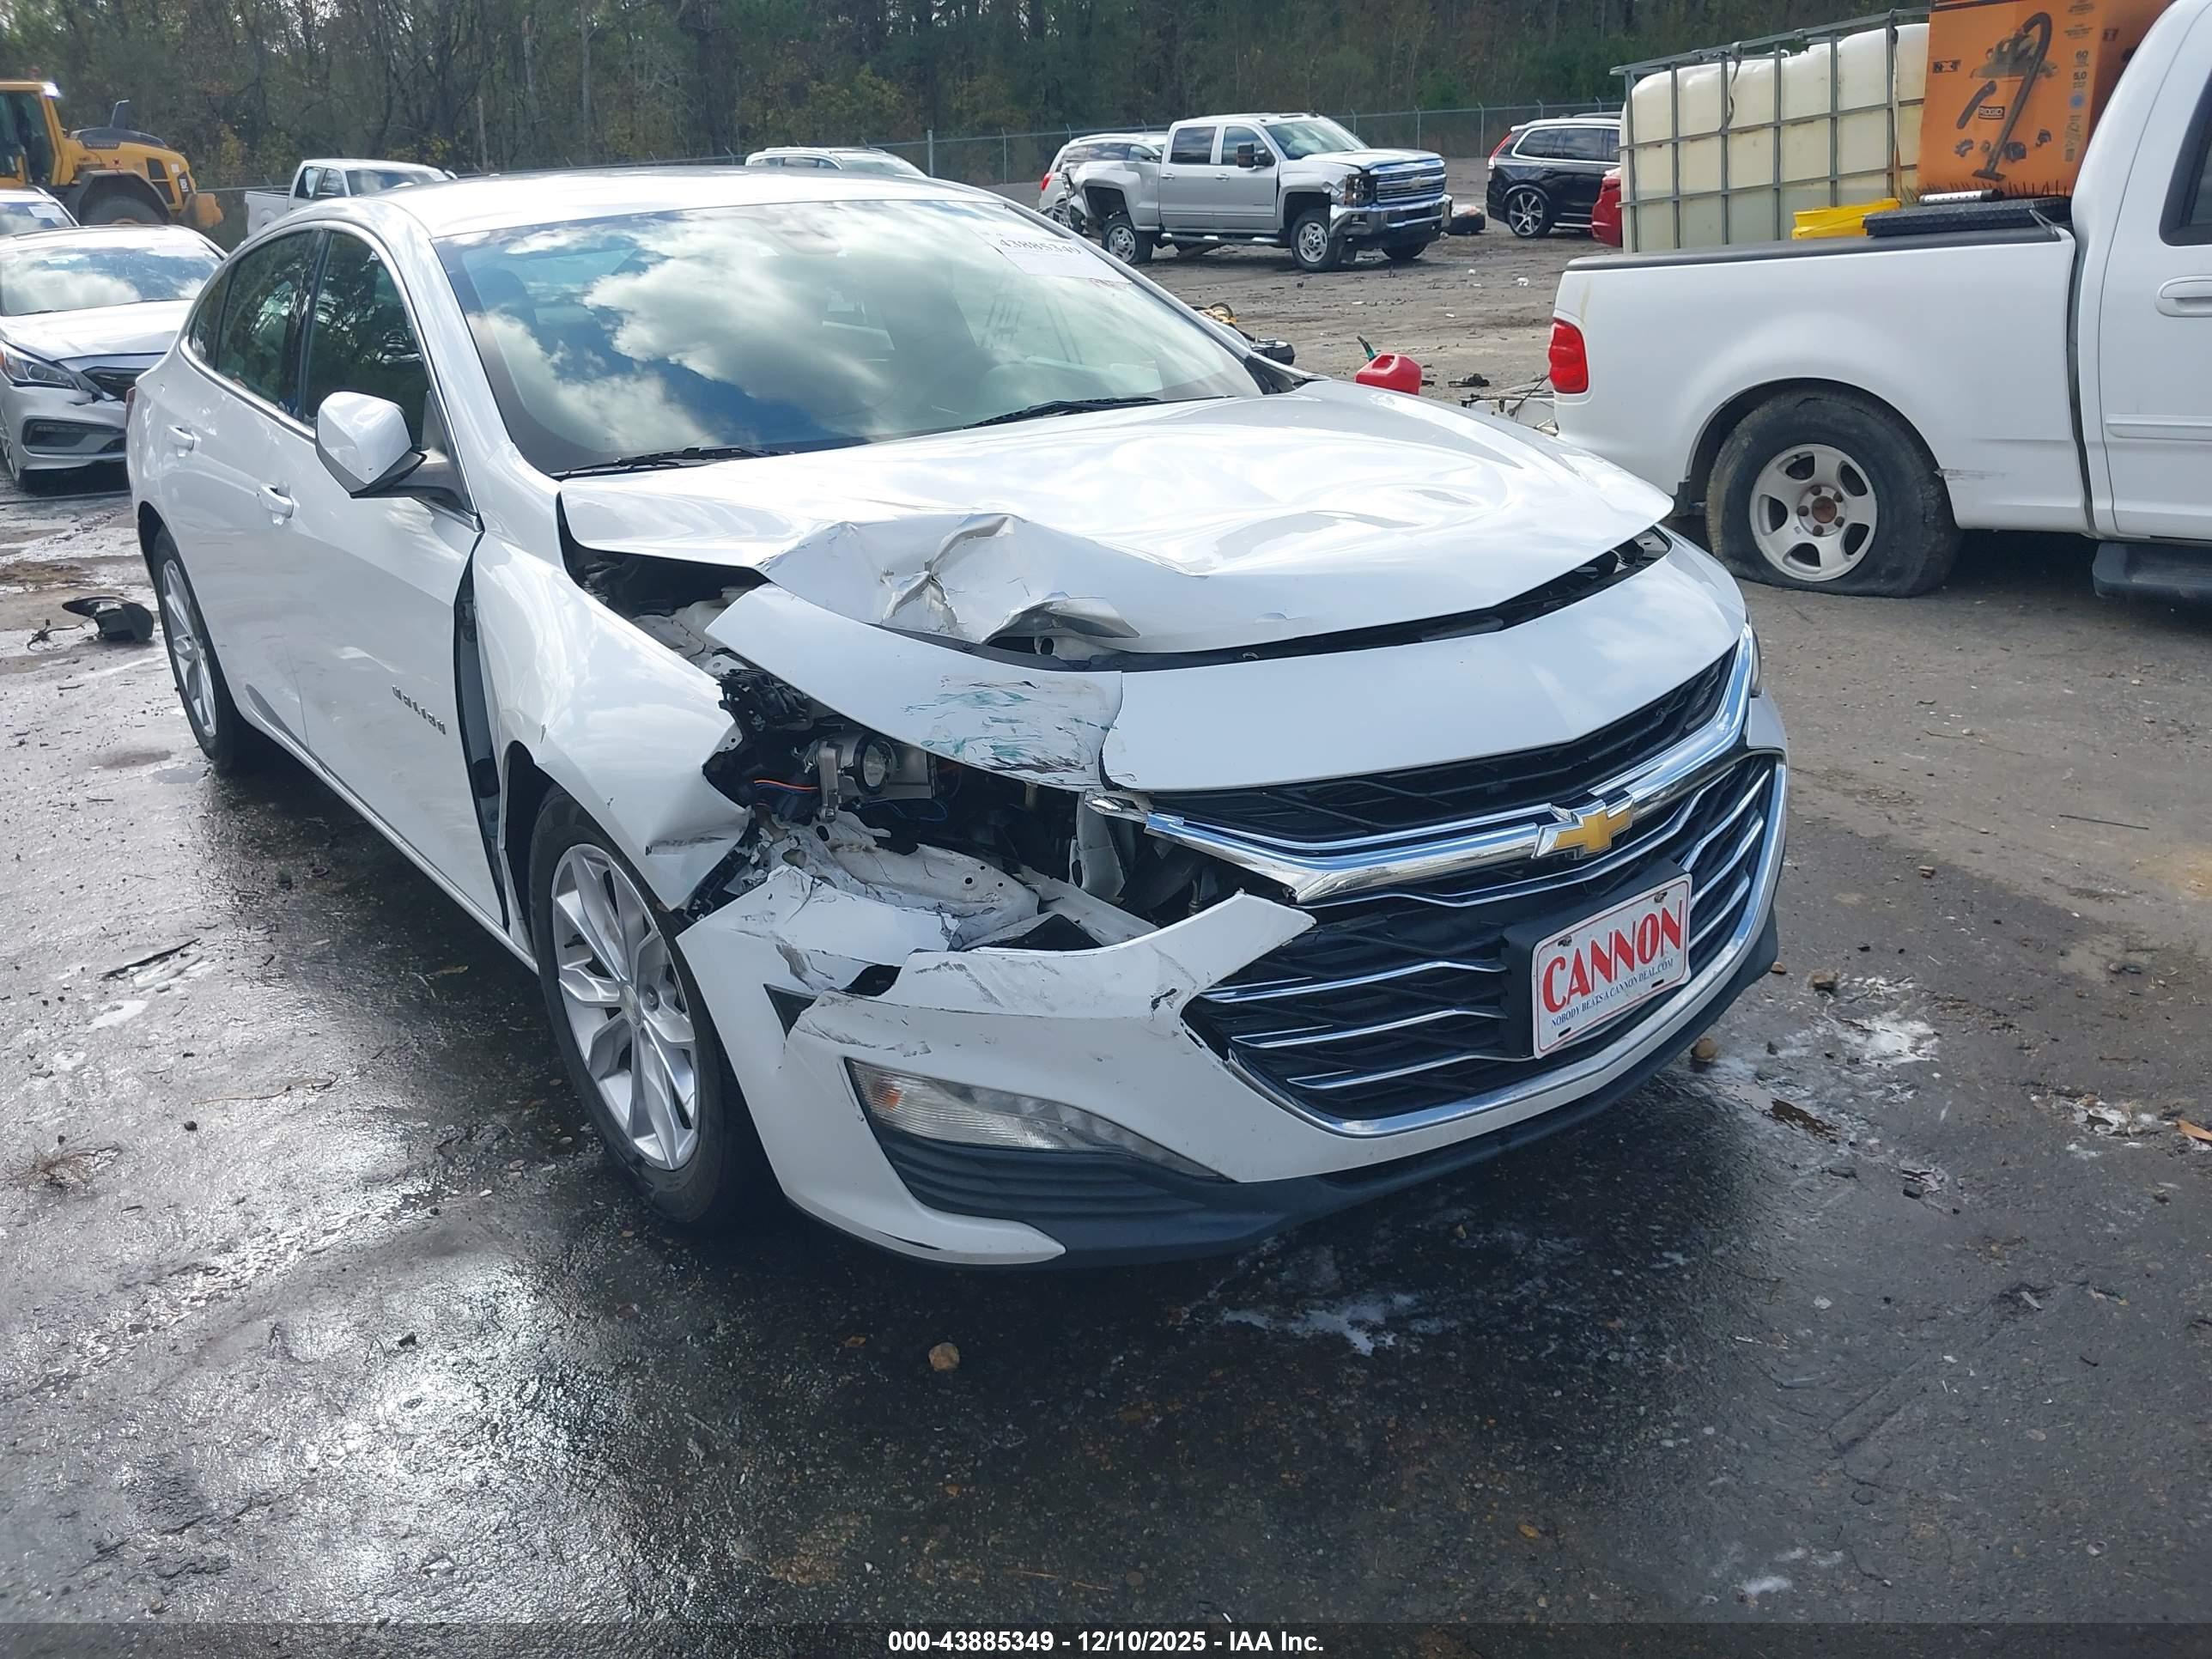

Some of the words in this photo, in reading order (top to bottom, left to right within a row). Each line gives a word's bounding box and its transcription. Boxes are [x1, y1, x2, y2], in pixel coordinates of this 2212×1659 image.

[1542, 899, 1683, 1013] CANNON
[1552, 1006, 1581, 1028] NOBODY
[1582, 994, 1604, 1012] BEATS
[1610, 977, 1638, 996] CANNON
[1638, 957, 1674, 982] DEAL.COM
